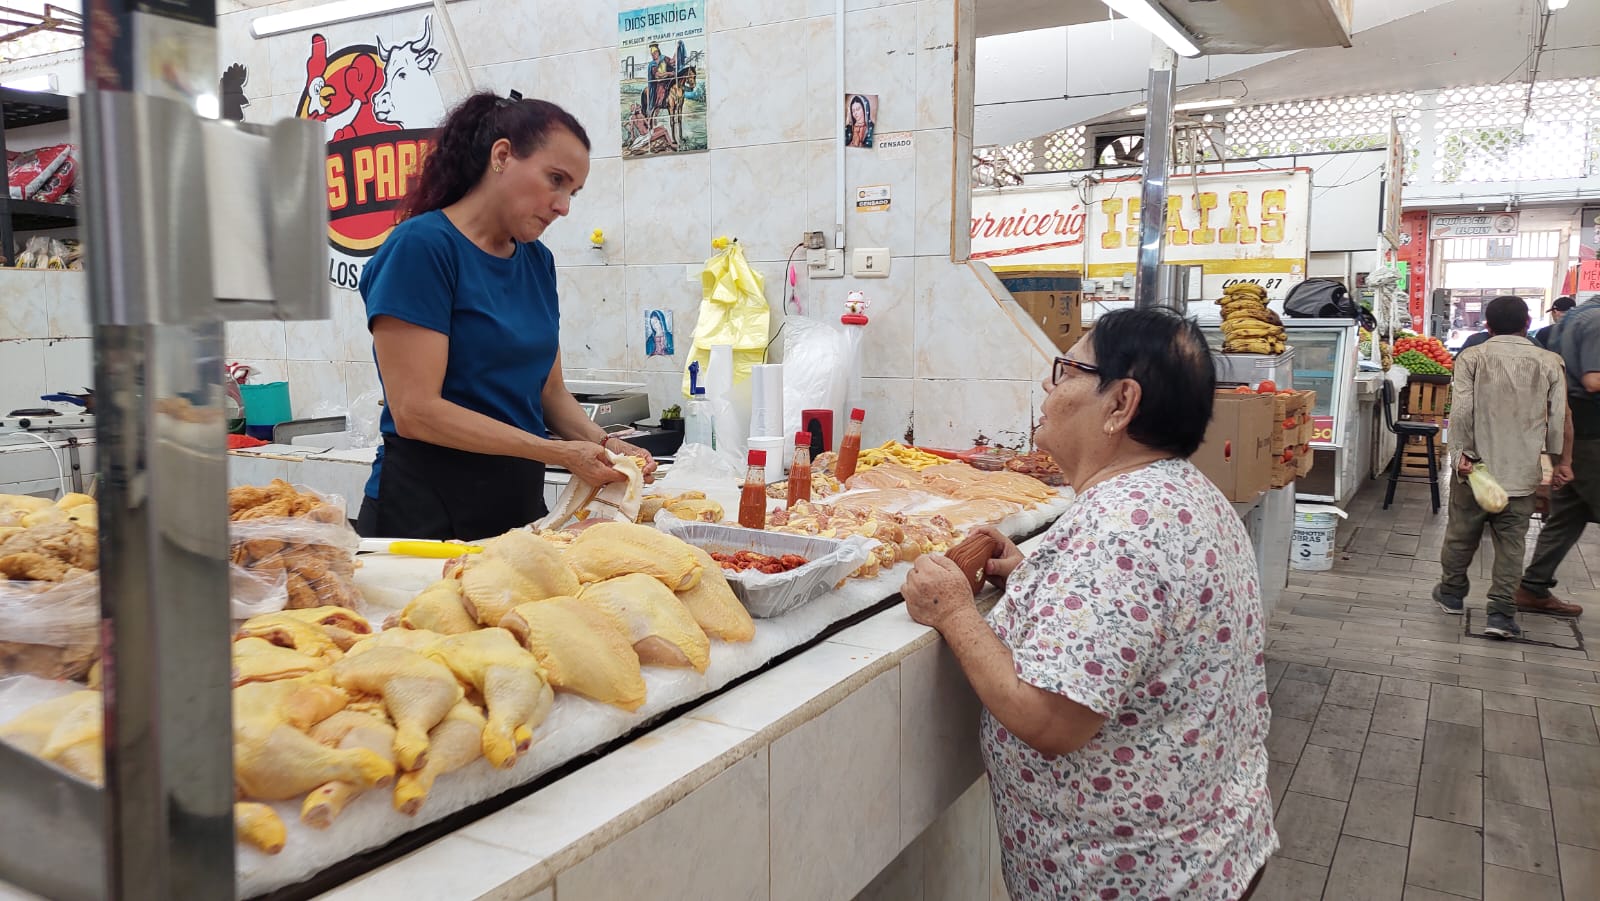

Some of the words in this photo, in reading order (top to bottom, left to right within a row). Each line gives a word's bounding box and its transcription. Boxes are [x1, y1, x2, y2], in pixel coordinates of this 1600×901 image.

[625, 16, 646, 31] DIOS
[648, 7, 697, 26] BENDIGA
[880, 140, 911, 148] CENSADO
[970, 204, 1087, 239] arnicería
[329, 258, 358, 288] LOS
[1266, 278, 1283, 289] 87
